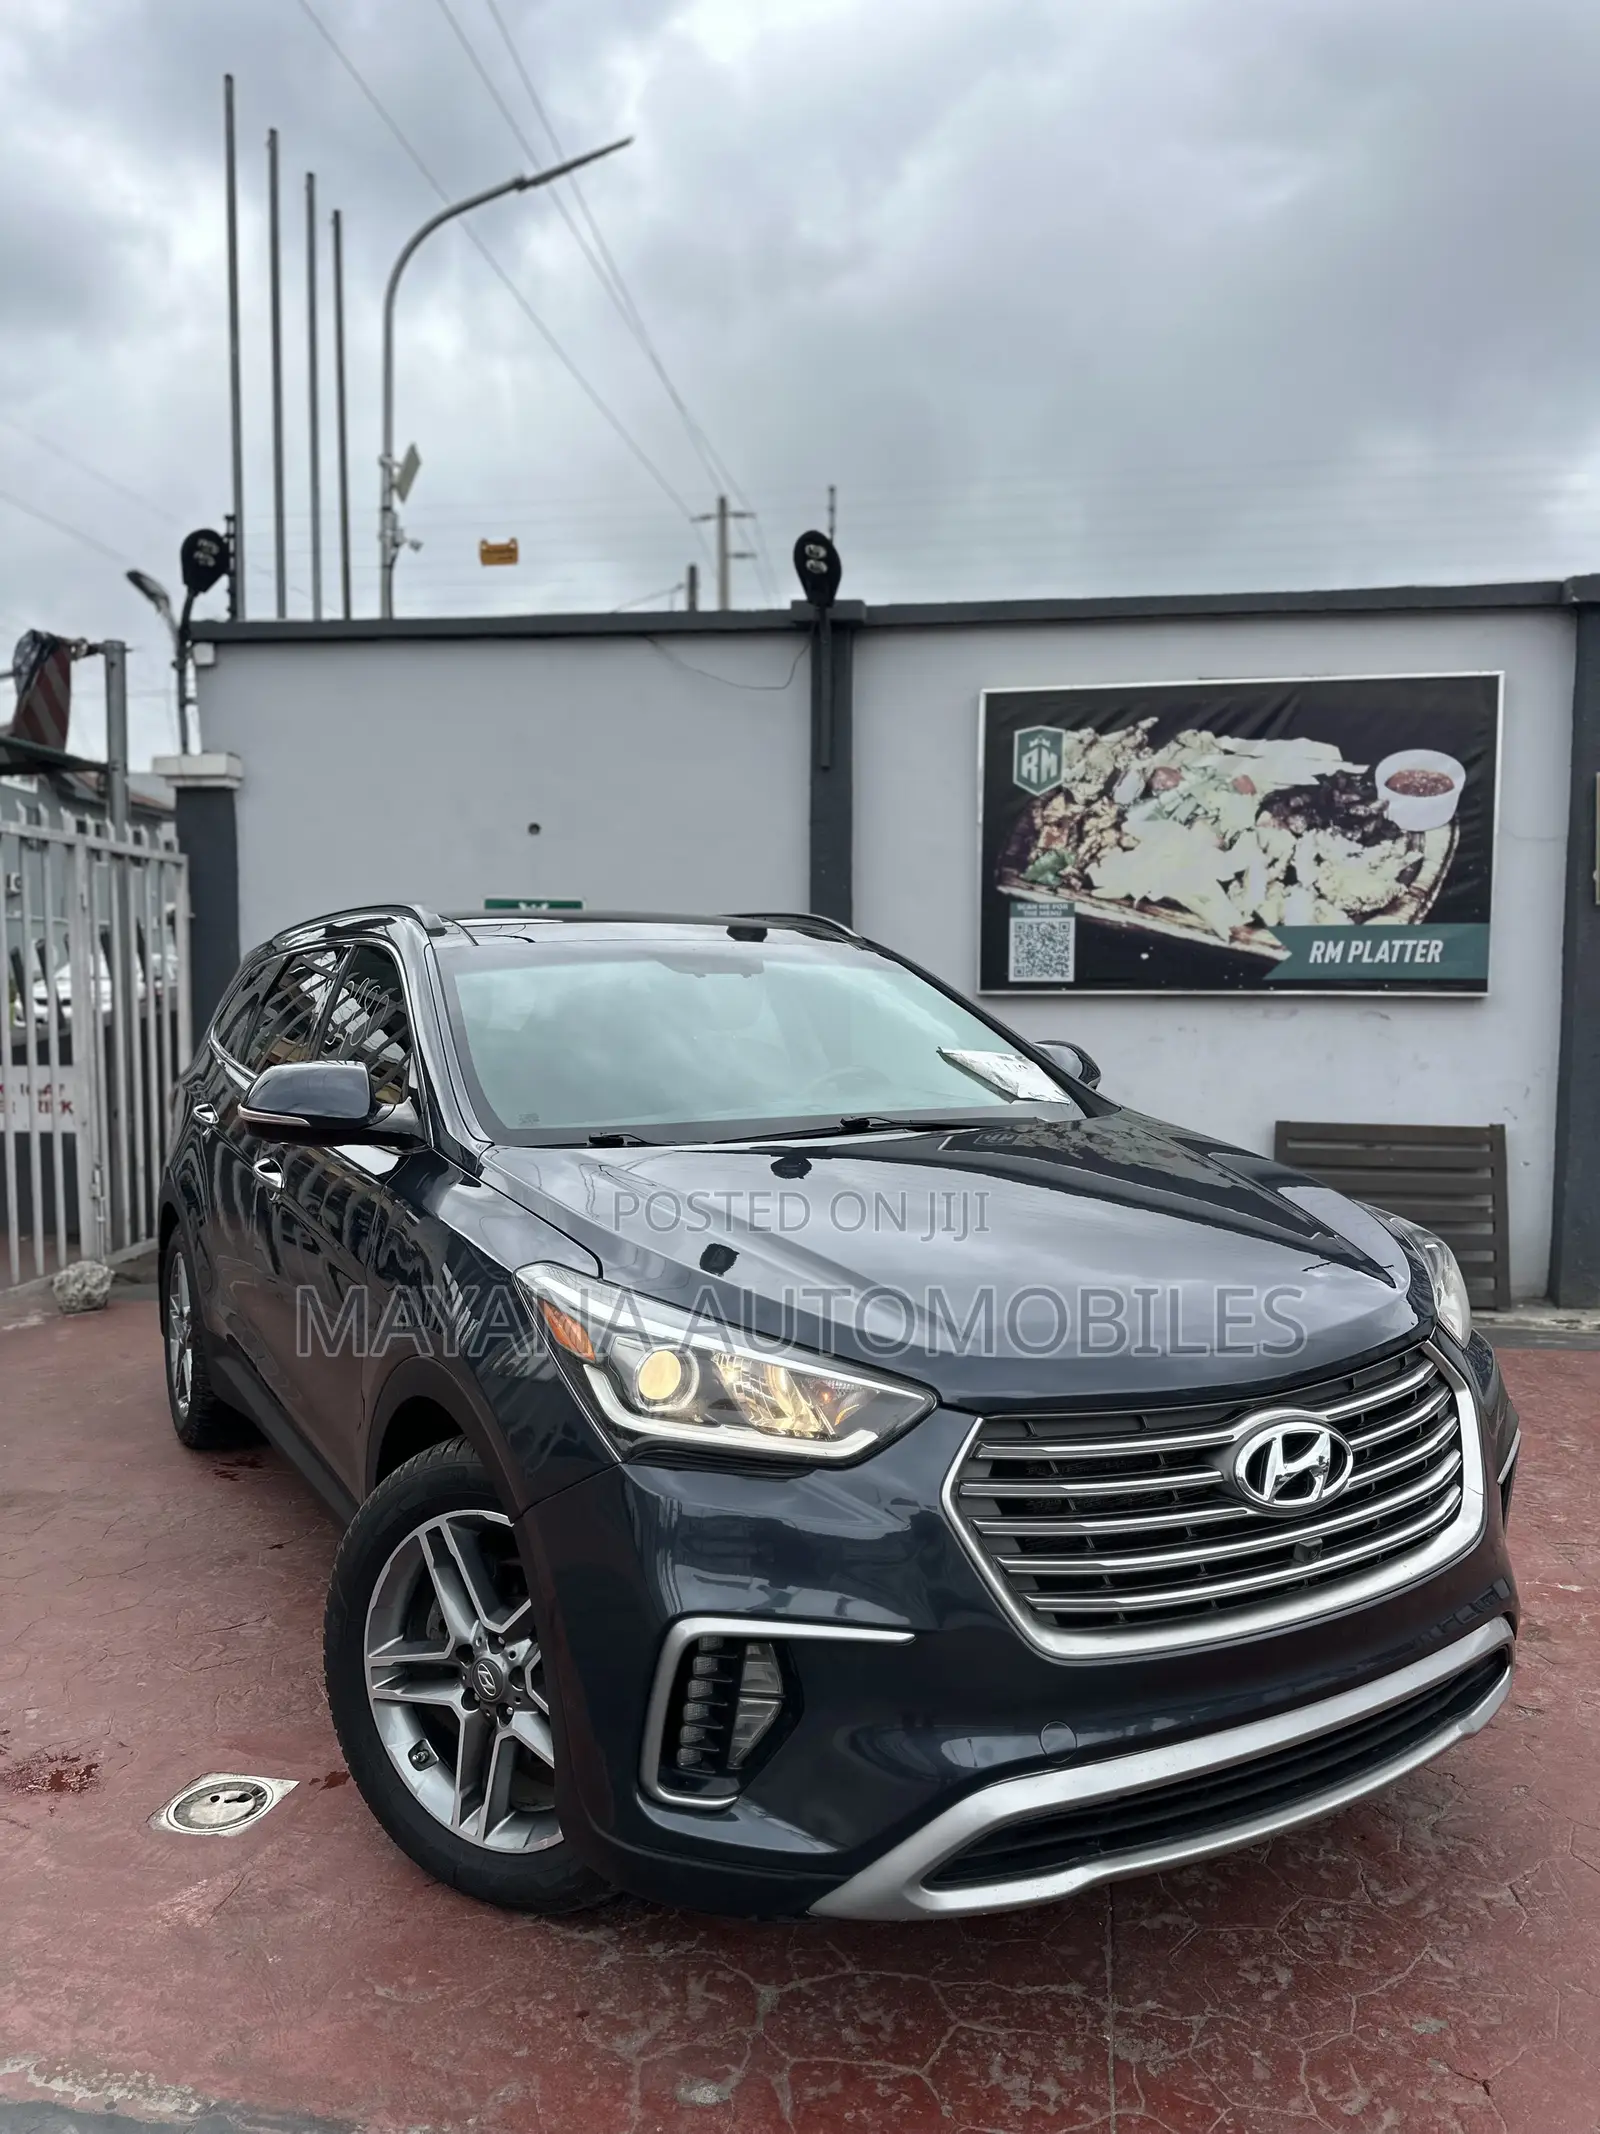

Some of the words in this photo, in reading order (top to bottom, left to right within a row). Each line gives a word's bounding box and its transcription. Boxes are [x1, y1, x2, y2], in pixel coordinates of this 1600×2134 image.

[1021, 747, 1058, 784] RM
[1308, 940, 1345, 964] RM
[1347, 939, 1444, 964] PLATTER
